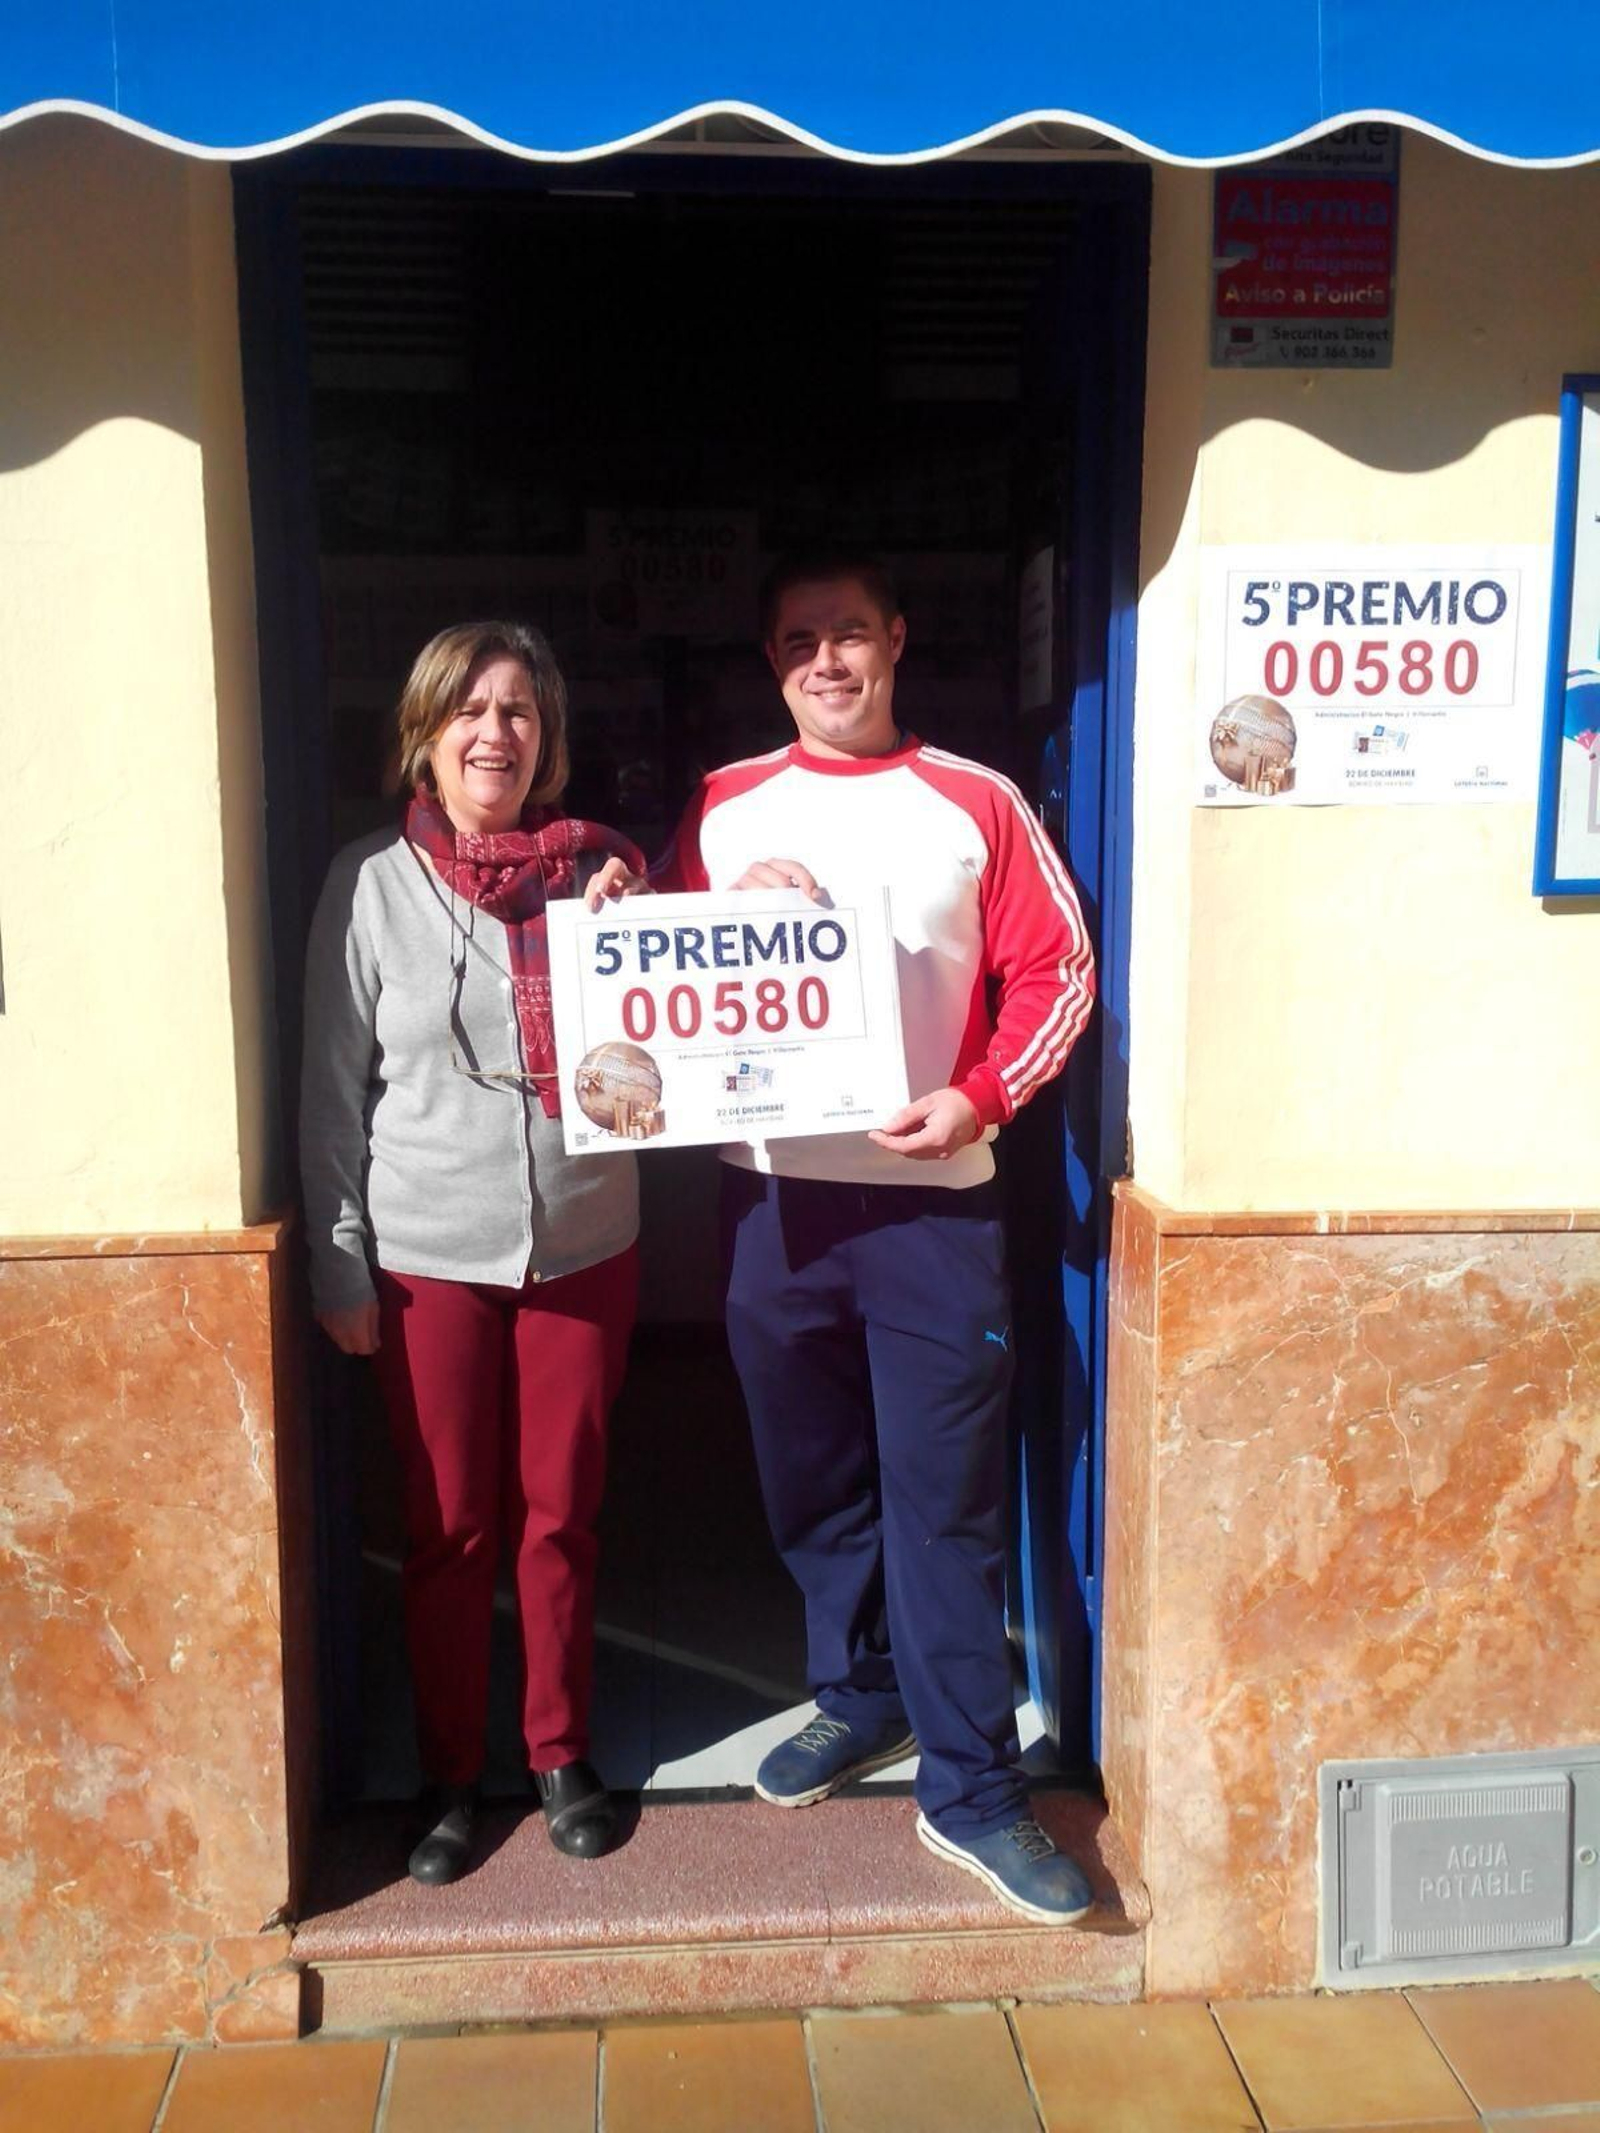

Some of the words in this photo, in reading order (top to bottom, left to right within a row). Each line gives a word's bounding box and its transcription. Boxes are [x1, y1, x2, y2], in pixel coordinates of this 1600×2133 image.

[1226, 185, 1388, 226] Alarma
[1262, 252, 1289, 271] de
[1224, 282, 1287, 303] Aviso
[1292, 287, 1307, 303] a
[1312, 281, 1387, 305] Policía
[1270, 326, 1340, 341] Securitas
[1343, 326, 1389, 341] Direct
[1294, 345, 1319, 359] 902
[1286, 579, 1508, 626] PREMIO
[1263, 639, 1480, 697] 00580
[1344, 768, 1356, 778] 22
[1357, 768, 1369, 778] DE
[1370, 767, 1416, 778] DICIEMBRE
[637, 919, 848, 973] PREMIO
[621, 975, 830, 1043] 00580
[728, 1106, 740, 1117] DE
[741, 1102, 785, 1115] DICIEMBRE
[1448, 1841, 1510, 1871] AGUA
[1419, 1869, 1535, 1903] POTABLE
